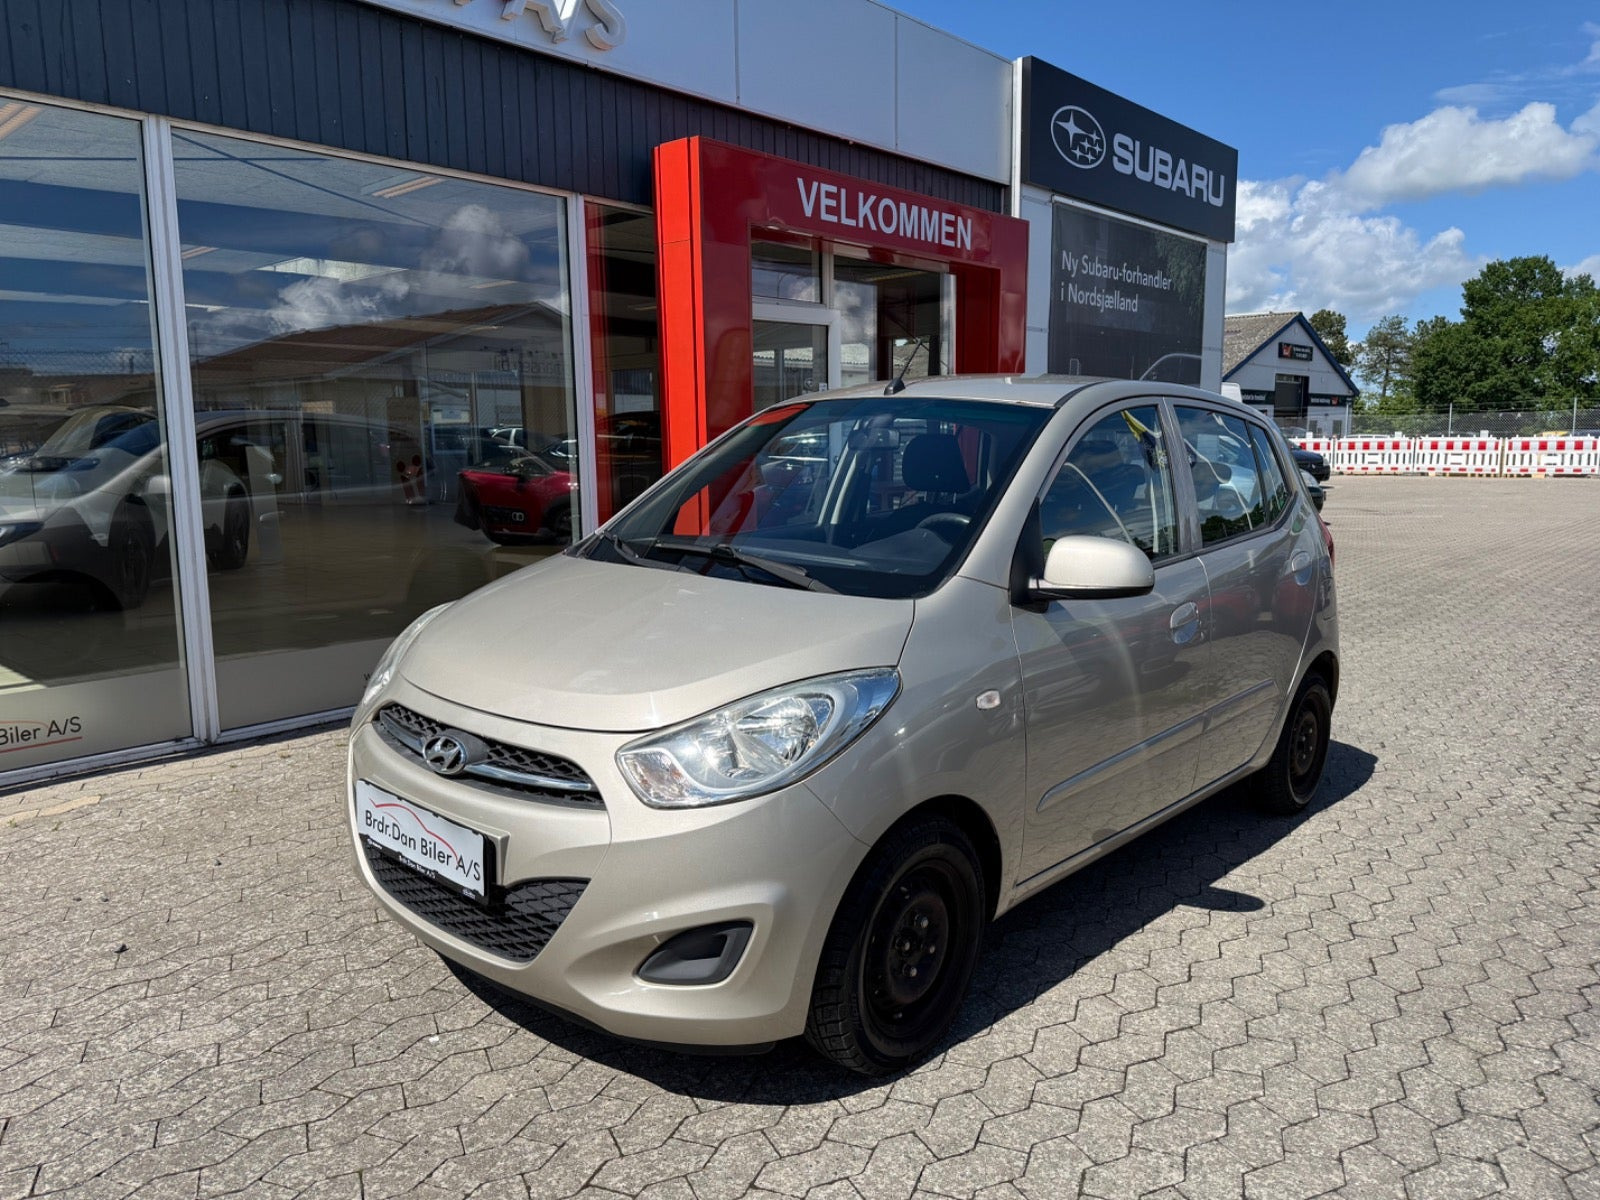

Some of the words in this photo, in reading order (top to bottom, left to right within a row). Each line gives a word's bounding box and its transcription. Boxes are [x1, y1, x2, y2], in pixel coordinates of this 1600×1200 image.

[1113, 133, 1225, 207] SUBARU
[797, 177, 972, 250] VELKOMMEN
[1062, 250, 1079, 278] Ny
[1082, 254, 1172, 290] Subaru-forhandler
[1060, 281, 1065, 302] i
[1068, 283, 1139, 313] Nordsjælland
[47, 716, 81, 737] A/S
[420, 837, 452, 866] Biler
[455, 854, 480, 881] A/S
